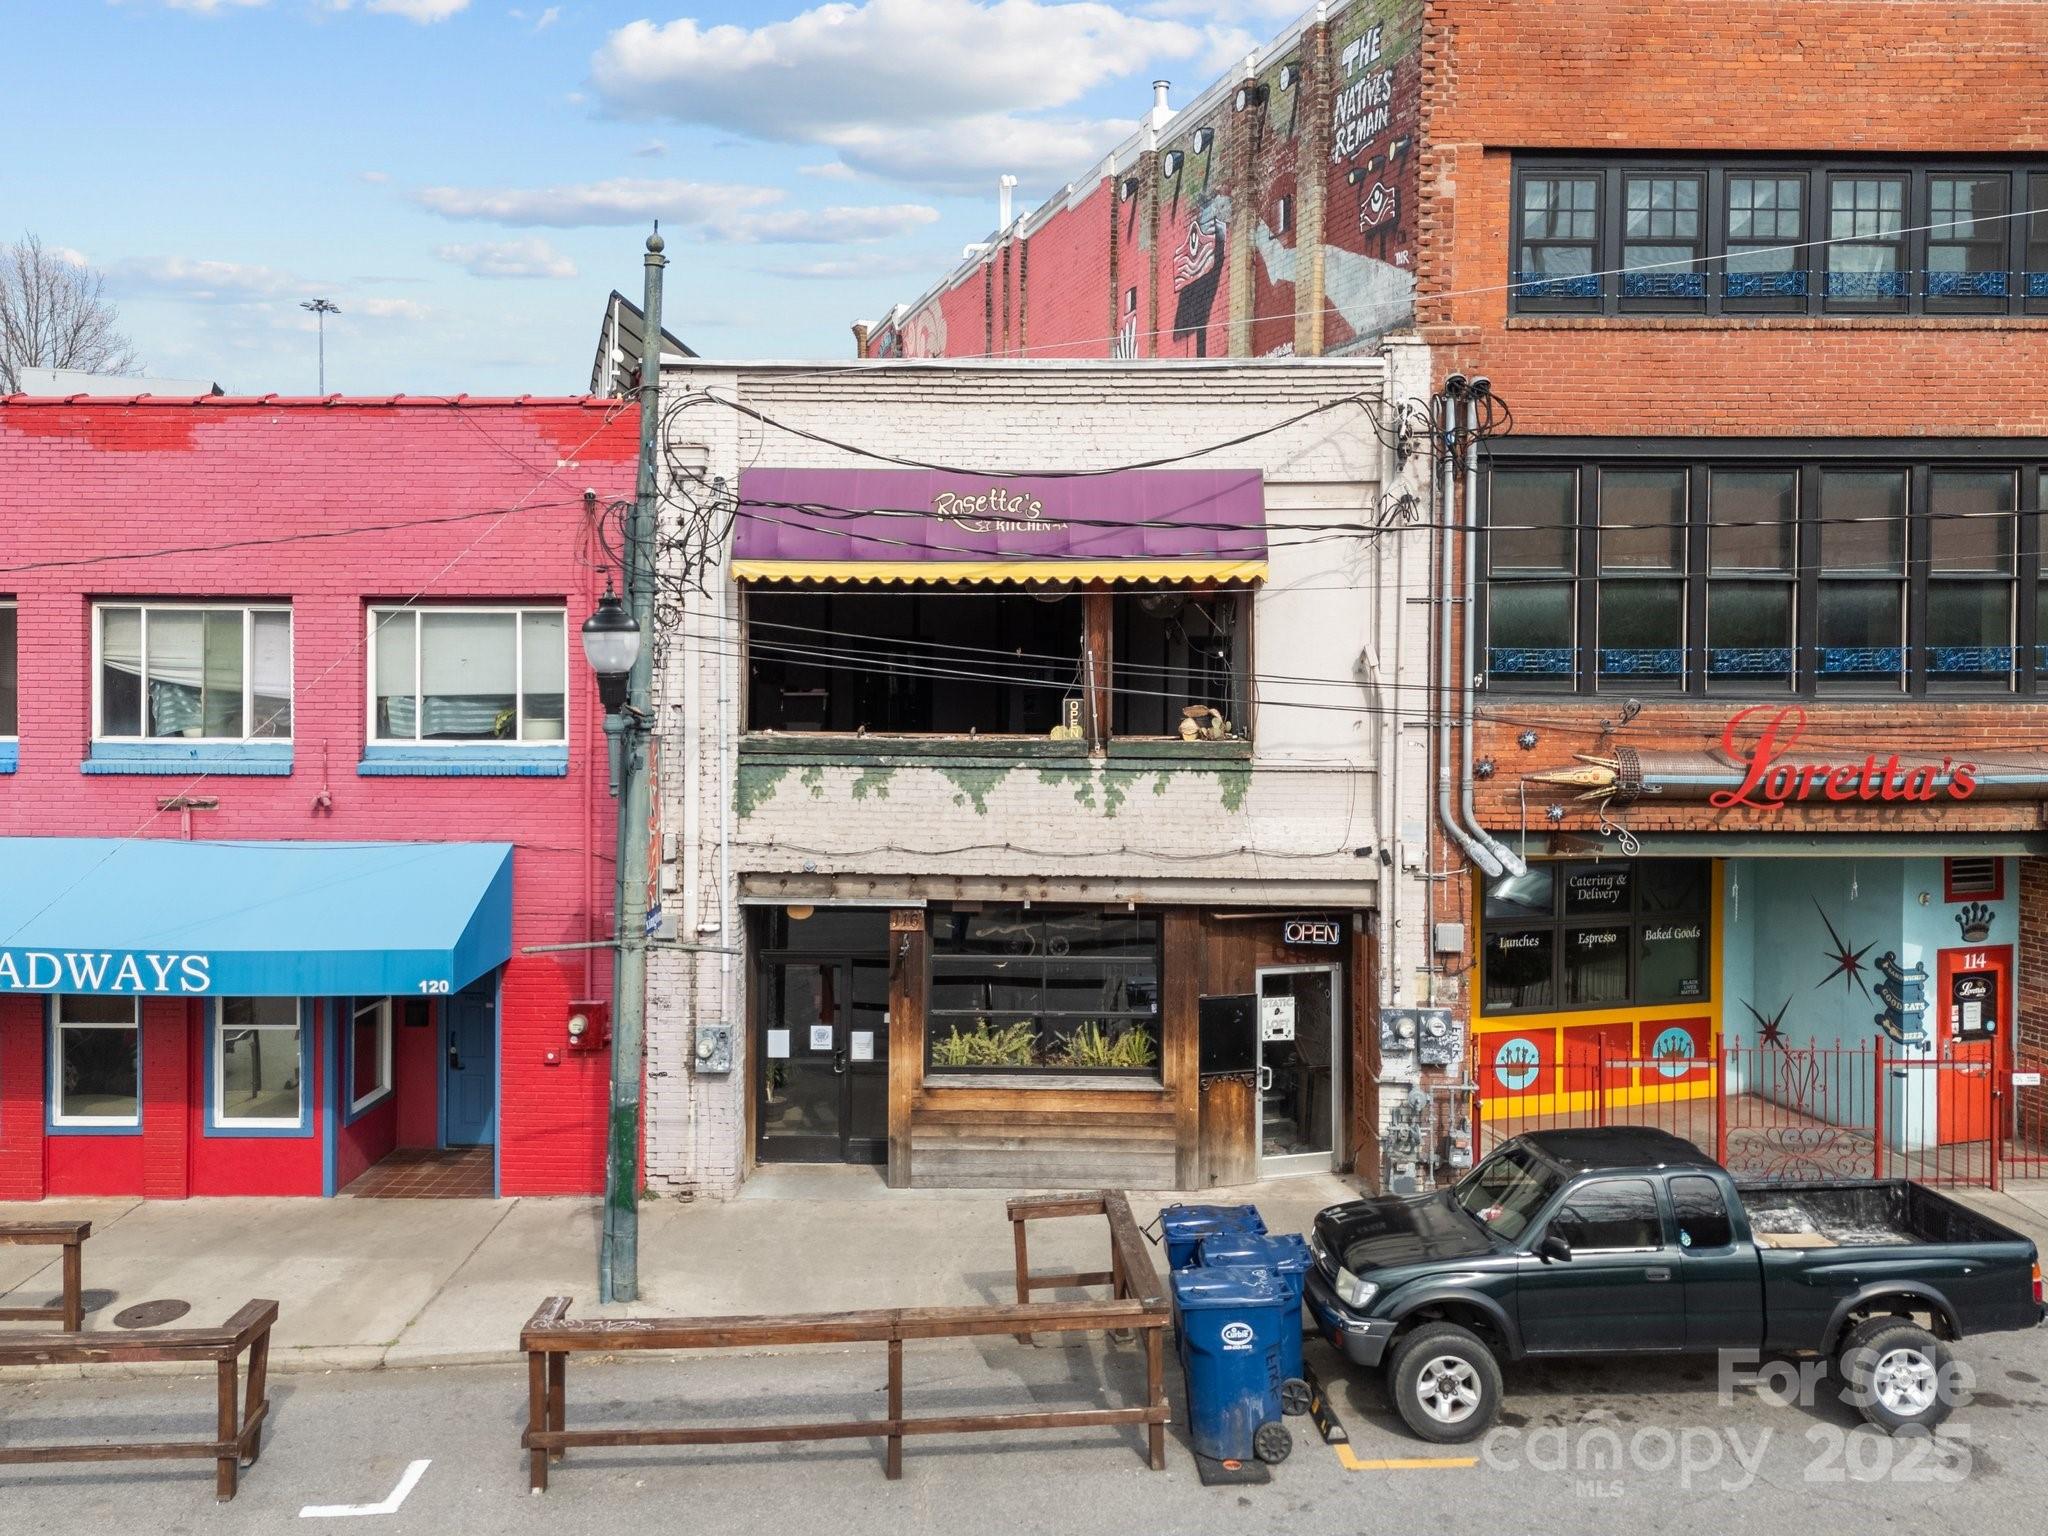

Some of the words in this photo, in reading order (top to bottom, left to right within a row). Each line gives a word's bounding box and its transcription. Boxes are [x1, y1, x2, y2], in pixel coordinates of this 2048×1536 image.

[1341, 26, 1382, 78] THE
[1334, 105, 1388, 164] REMAIN
[932, 488, 1042, 521] Rosetta's
[1070, 701, 1079, 738] OPEN
[1709, 704, 1977, 809] Loretta's
[1569, 874, 1613, 889] Catering
[1616, 874, 1627, 886] &
[1578, 888, 1620, 903] Delivery
[1286, 923, 1338, 942] OPEN
[1500, 934, 1540, 949] Lunches
[1578, 932, 1617, 948] Espresso
[1645, 927, 1672, 941] Baked
[1674, 925, 1700, 940] Goods
[1963, 953, 1987, 969] 114
[0, 952, 211, 992] ADWAYS
[418, 980, 450, 993] 120
[1882, 988, 1903, 1010] GOOD
[1903, 1002, 1926, 1012] EATS
